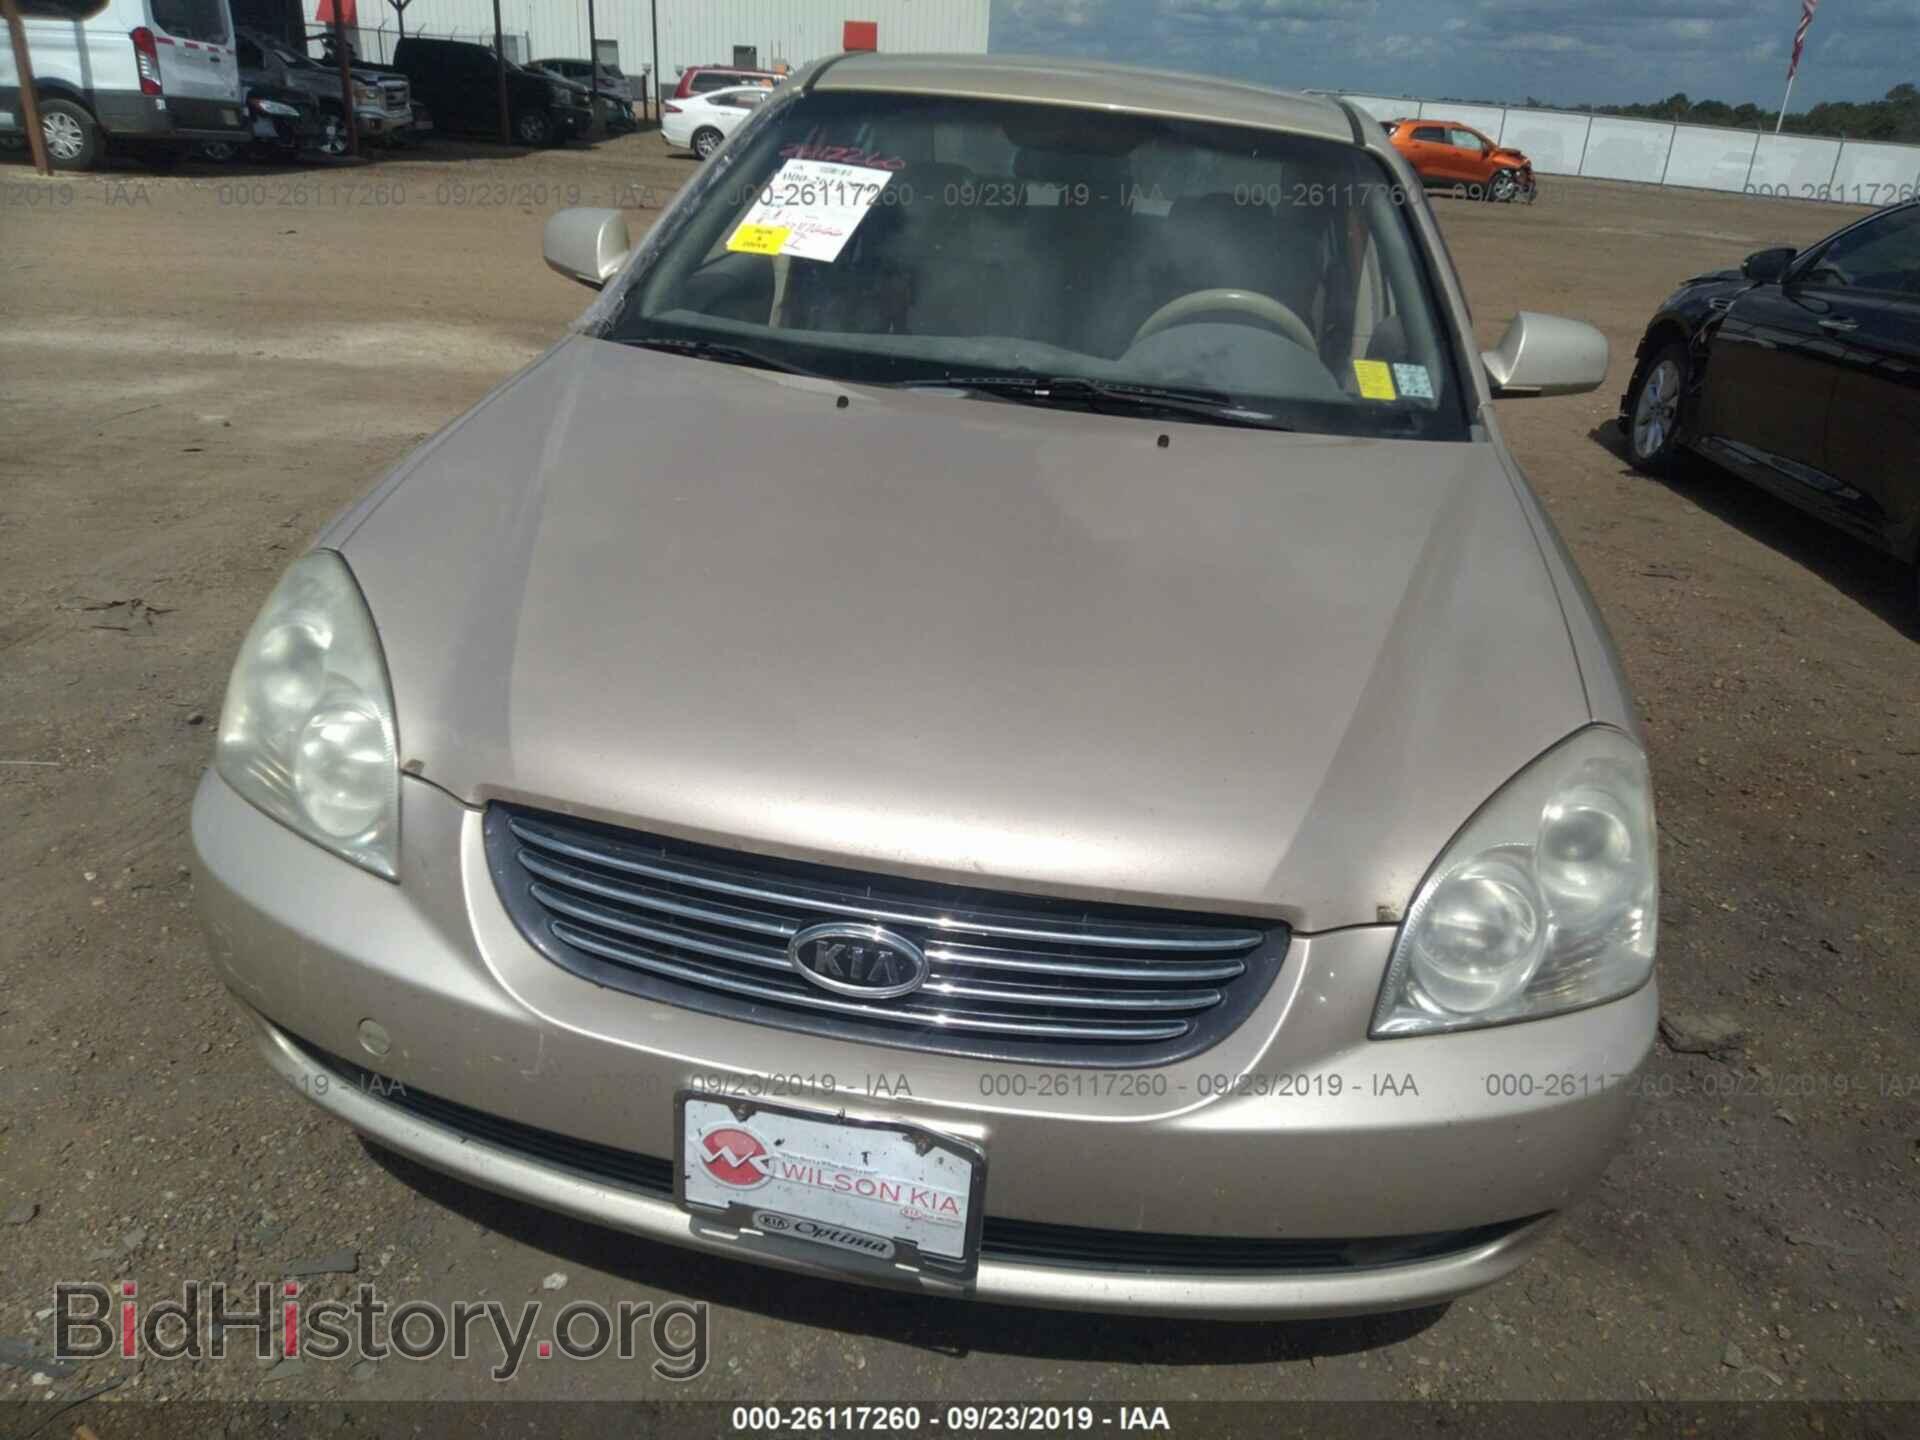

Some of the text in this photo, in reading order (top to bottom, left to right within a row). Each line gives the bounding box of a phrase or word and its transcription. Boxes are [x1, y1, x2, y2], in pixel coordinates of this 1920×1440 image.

[814, 940, 900, 984] KIA
[782, 1161, 901, 1202] WILSON
[910, 1187, 960, 1215] KIA
[763, 1216, 887, 1252] KIA Optima
